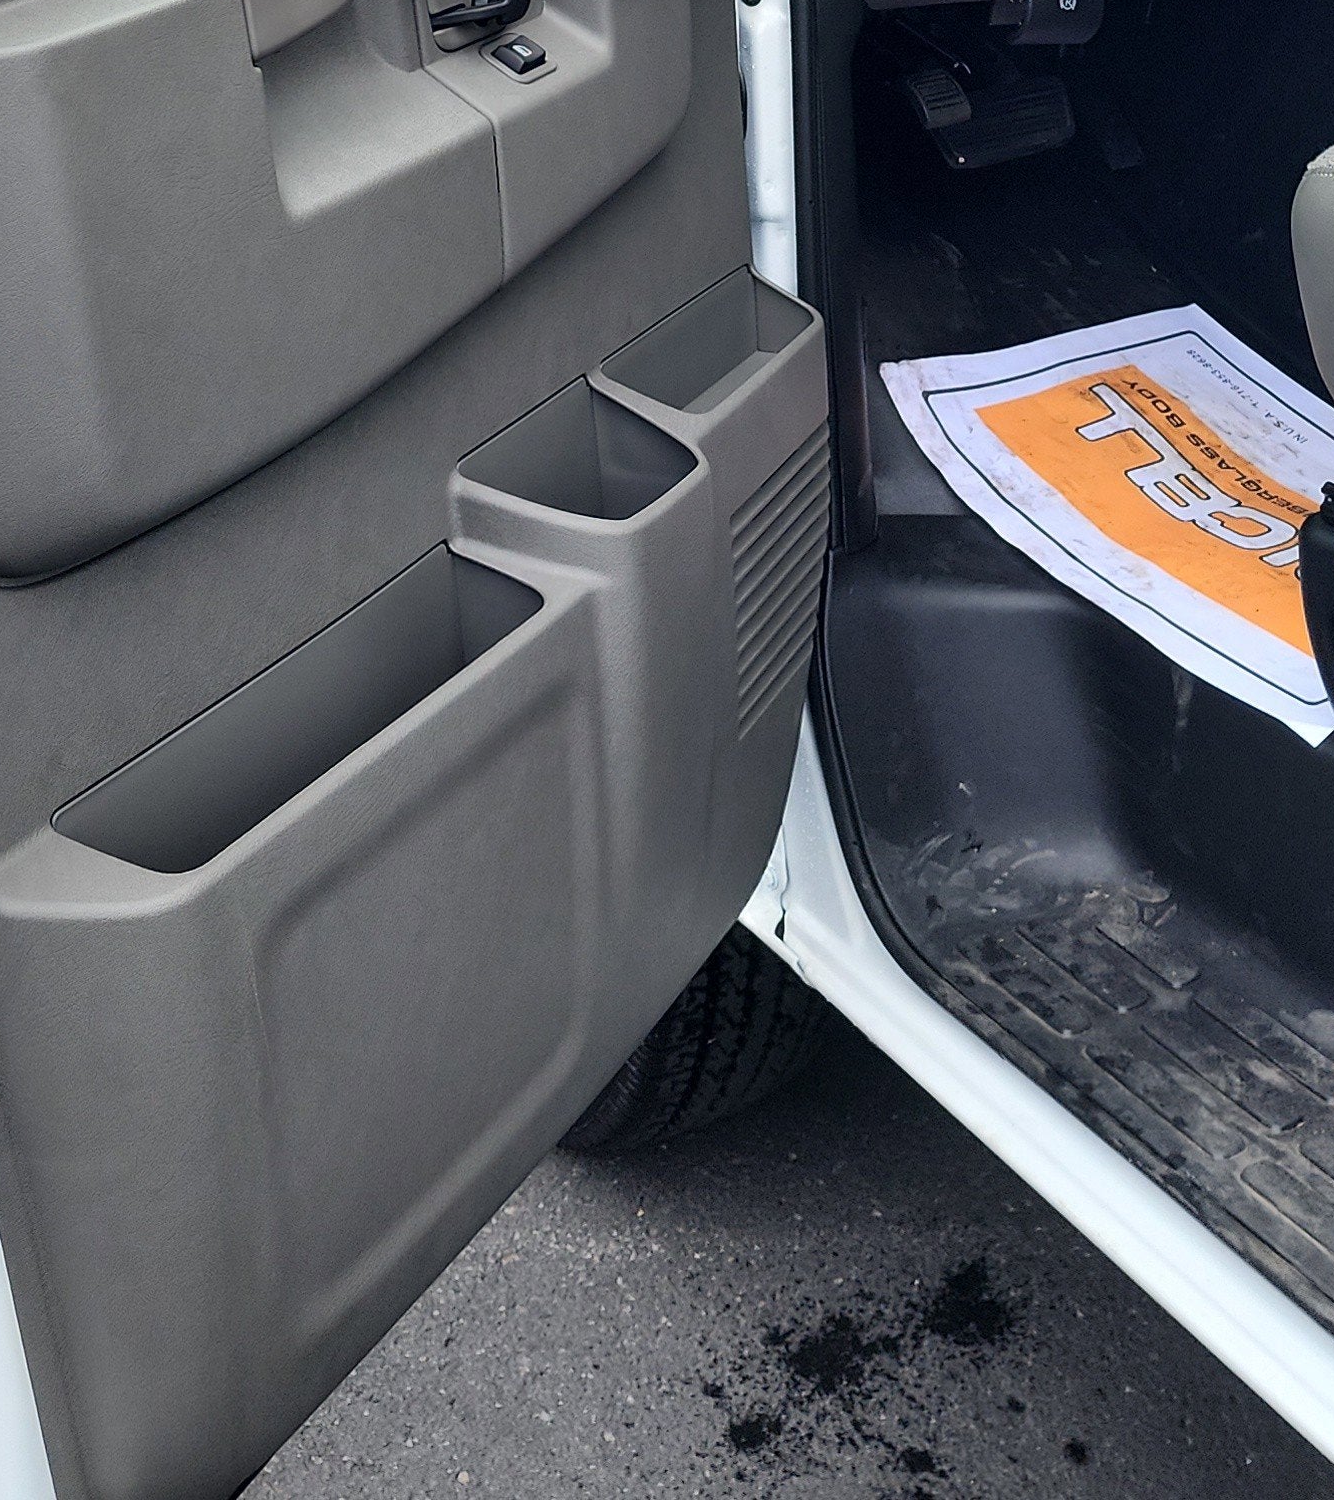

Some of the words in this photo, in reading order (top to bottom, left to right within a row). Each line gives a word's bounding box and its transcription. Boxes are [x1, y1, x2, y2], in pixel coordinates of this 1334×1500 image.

[1121, 379, 1186, 428] BODY
[1075, 382, 1301, 581] ICELL
[1185, 433, 1316, 517] BERGLASS
